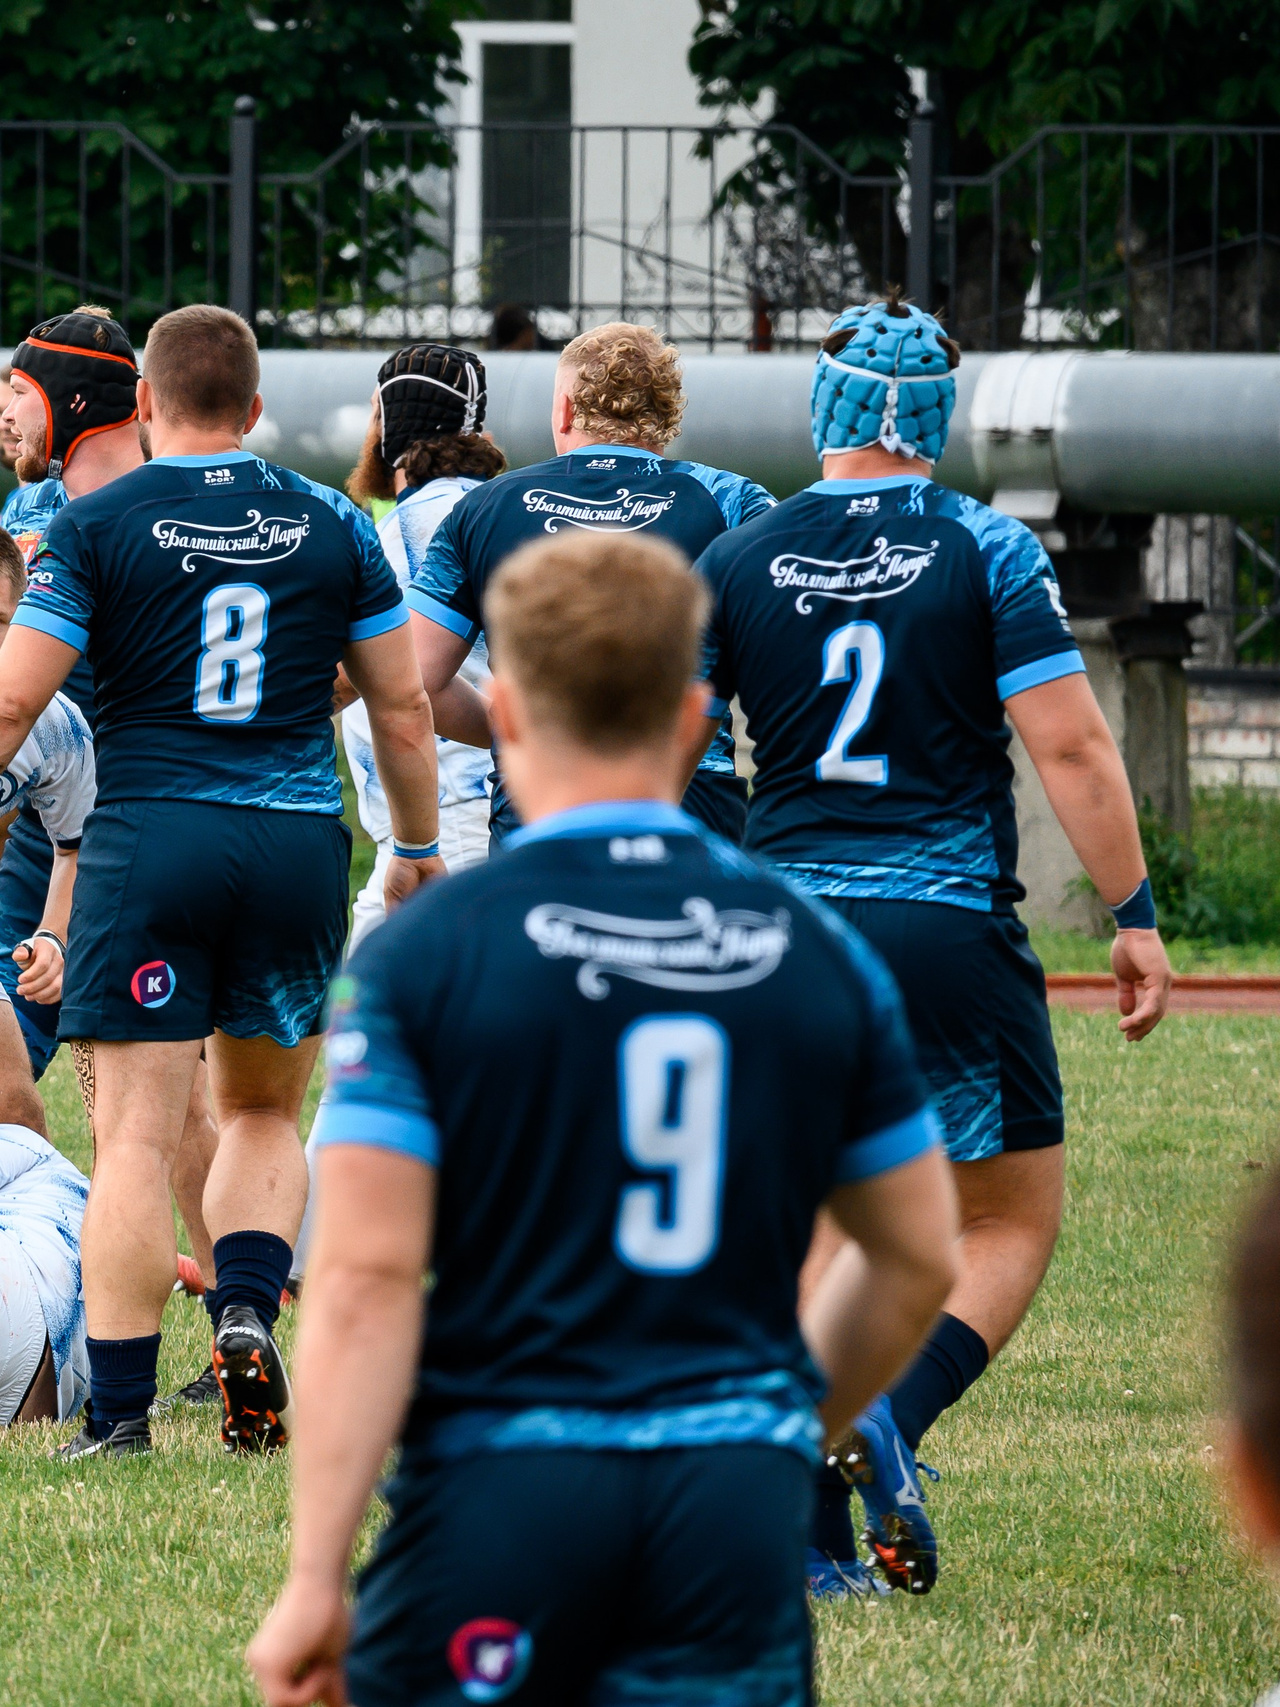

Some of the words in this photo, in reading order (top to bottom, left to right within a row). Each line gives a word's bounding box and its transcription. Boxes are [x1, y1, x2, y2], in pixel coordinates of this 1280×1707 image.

[204, 476, 236, 484] SPORT
[193, 582, 270, 724] 8
[816, 620, 889, 787] 2
[147, 976, 163, 993] K
[614, 1011, 731, 1278] 9
